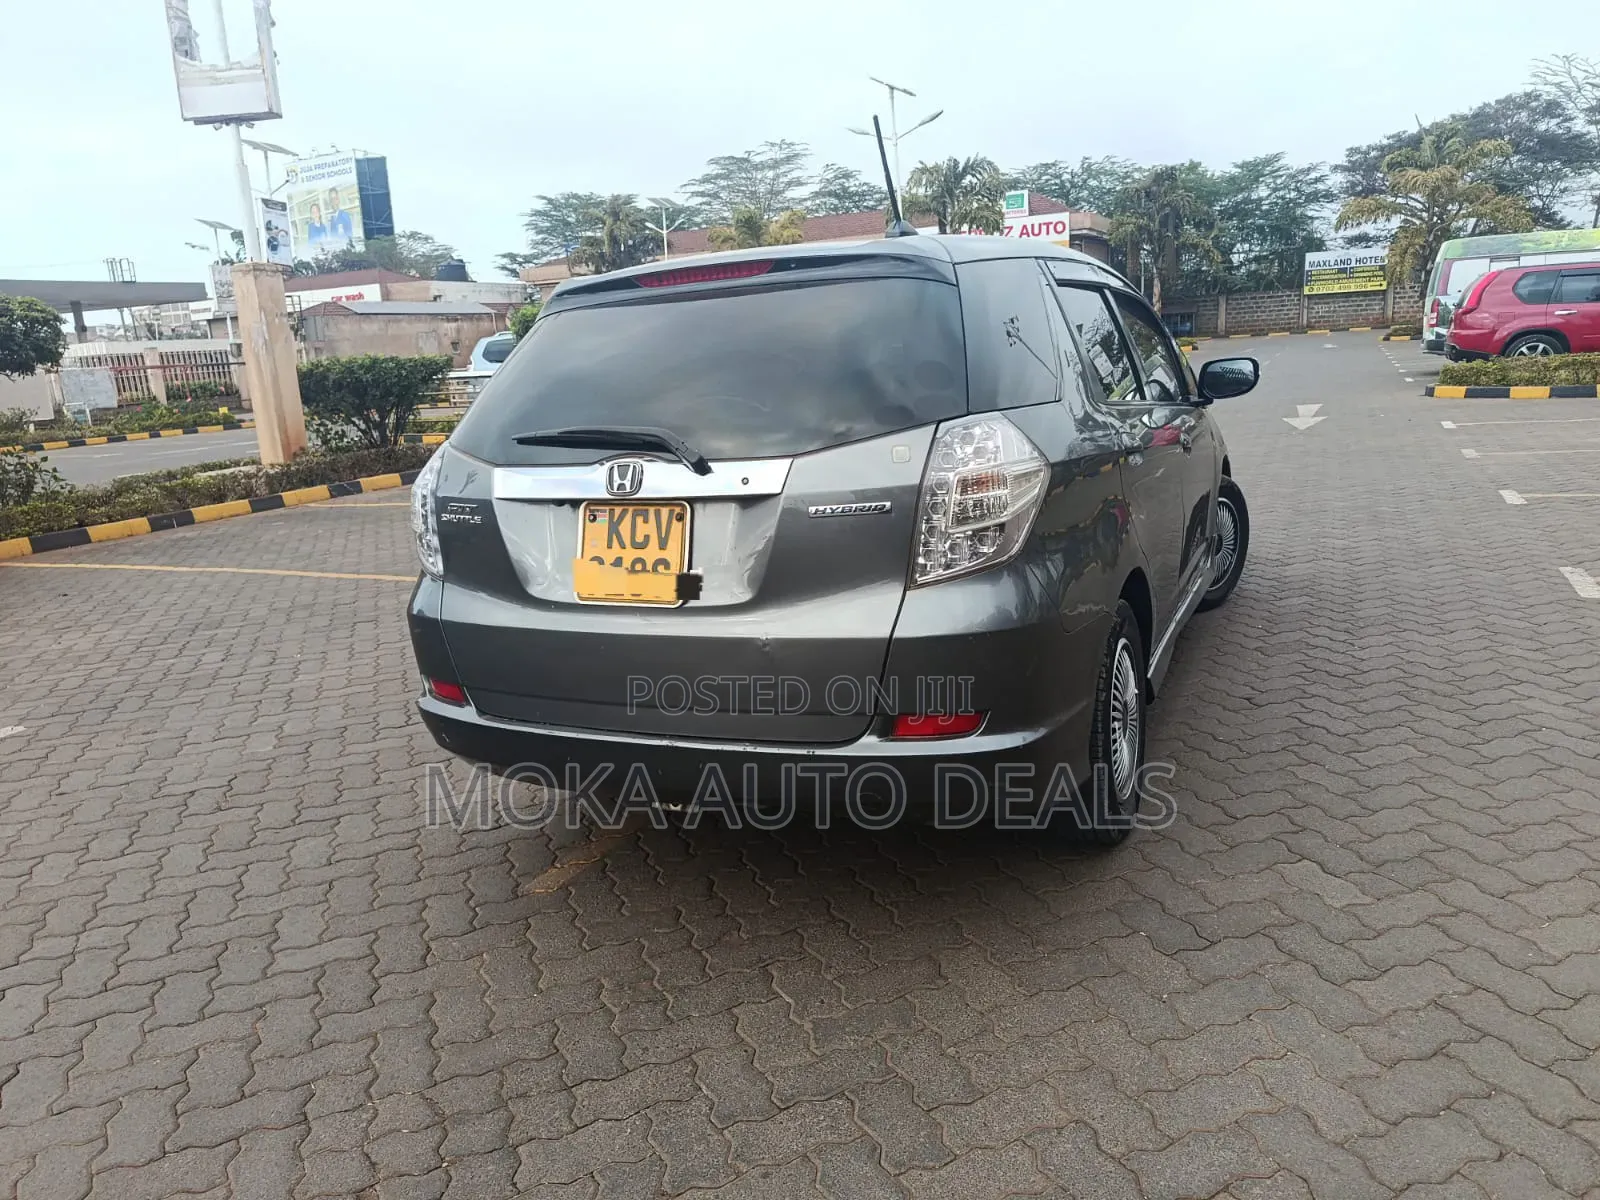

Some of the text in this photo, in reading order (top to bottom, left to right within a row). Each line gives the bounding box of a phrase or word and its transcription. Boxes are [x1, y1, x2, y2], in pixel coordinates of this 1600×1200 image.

[314, 157, 353, 170] PREPARATORY
[327, 166, 353, 178] SCHOOLS
[1019, 221, 1066, 238] AUTO
[1308, 258, 1352, 269] MAXLAND
[810, 503, 888, 515] HYBRID
[441, 513, 483, 524] SHUTTLE
[607, 509, 676, 550] KCV
